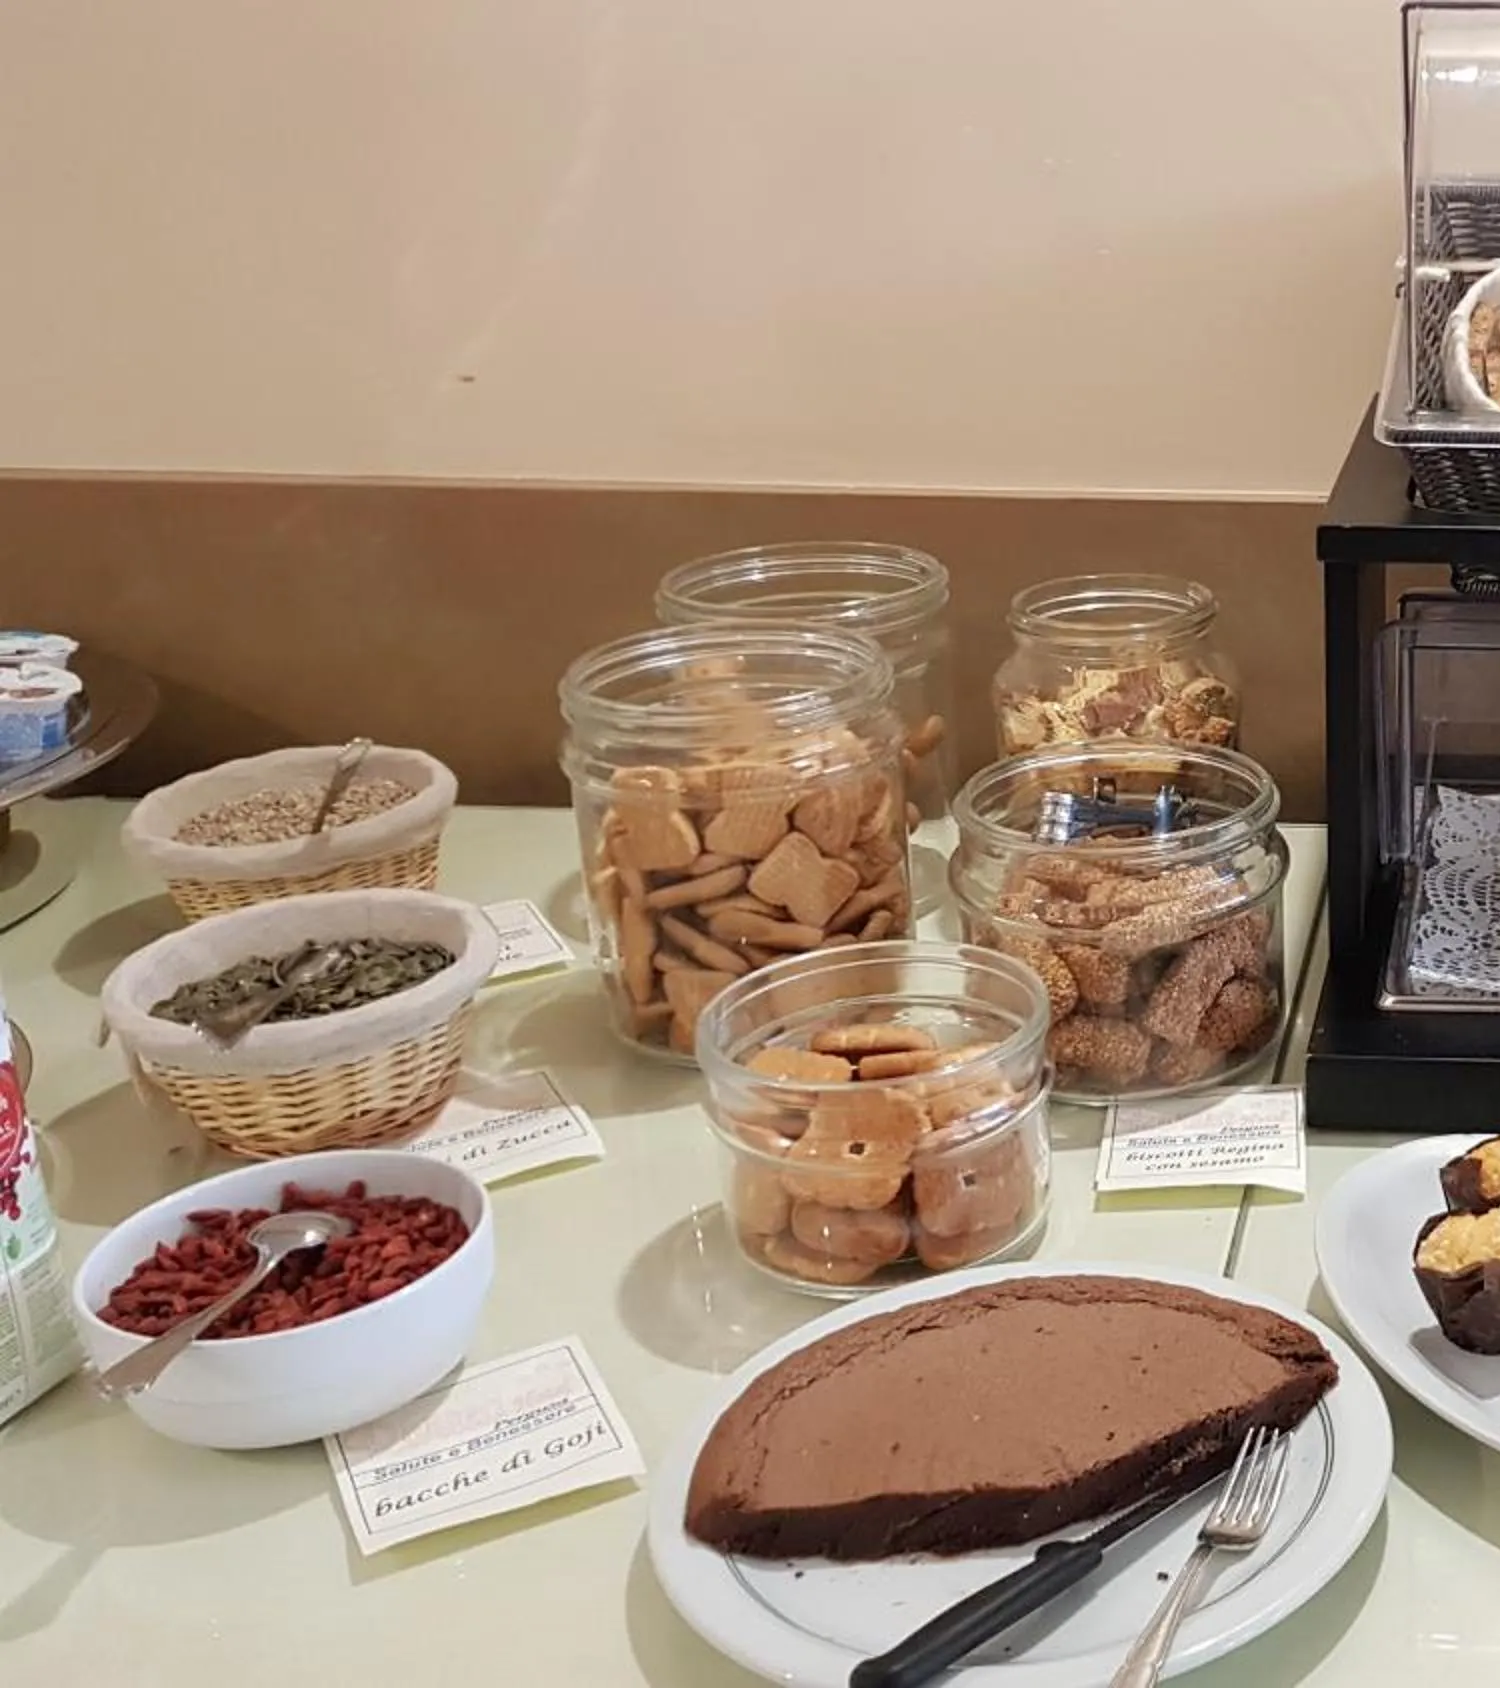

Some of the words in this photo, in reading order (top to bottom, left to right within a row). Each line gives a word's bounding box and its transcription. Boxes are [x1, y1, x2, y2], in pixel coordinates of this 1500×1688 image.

[496, 1119, 571, 1151] Zucca
[1210, 1142, 1285, 1156] Regina
[1144, 1162, 1182, 1172] con
[1189, 1156, 1265, 1169] sesamo
[373, 1453, 443, 1481] Salute
[466, 1403, 577, 1451] Benessere
[375, 1470, 490, 1517] bacche
[501, 1449, 534, 1475] di
[544, 1420, 608, 1459] Goji
